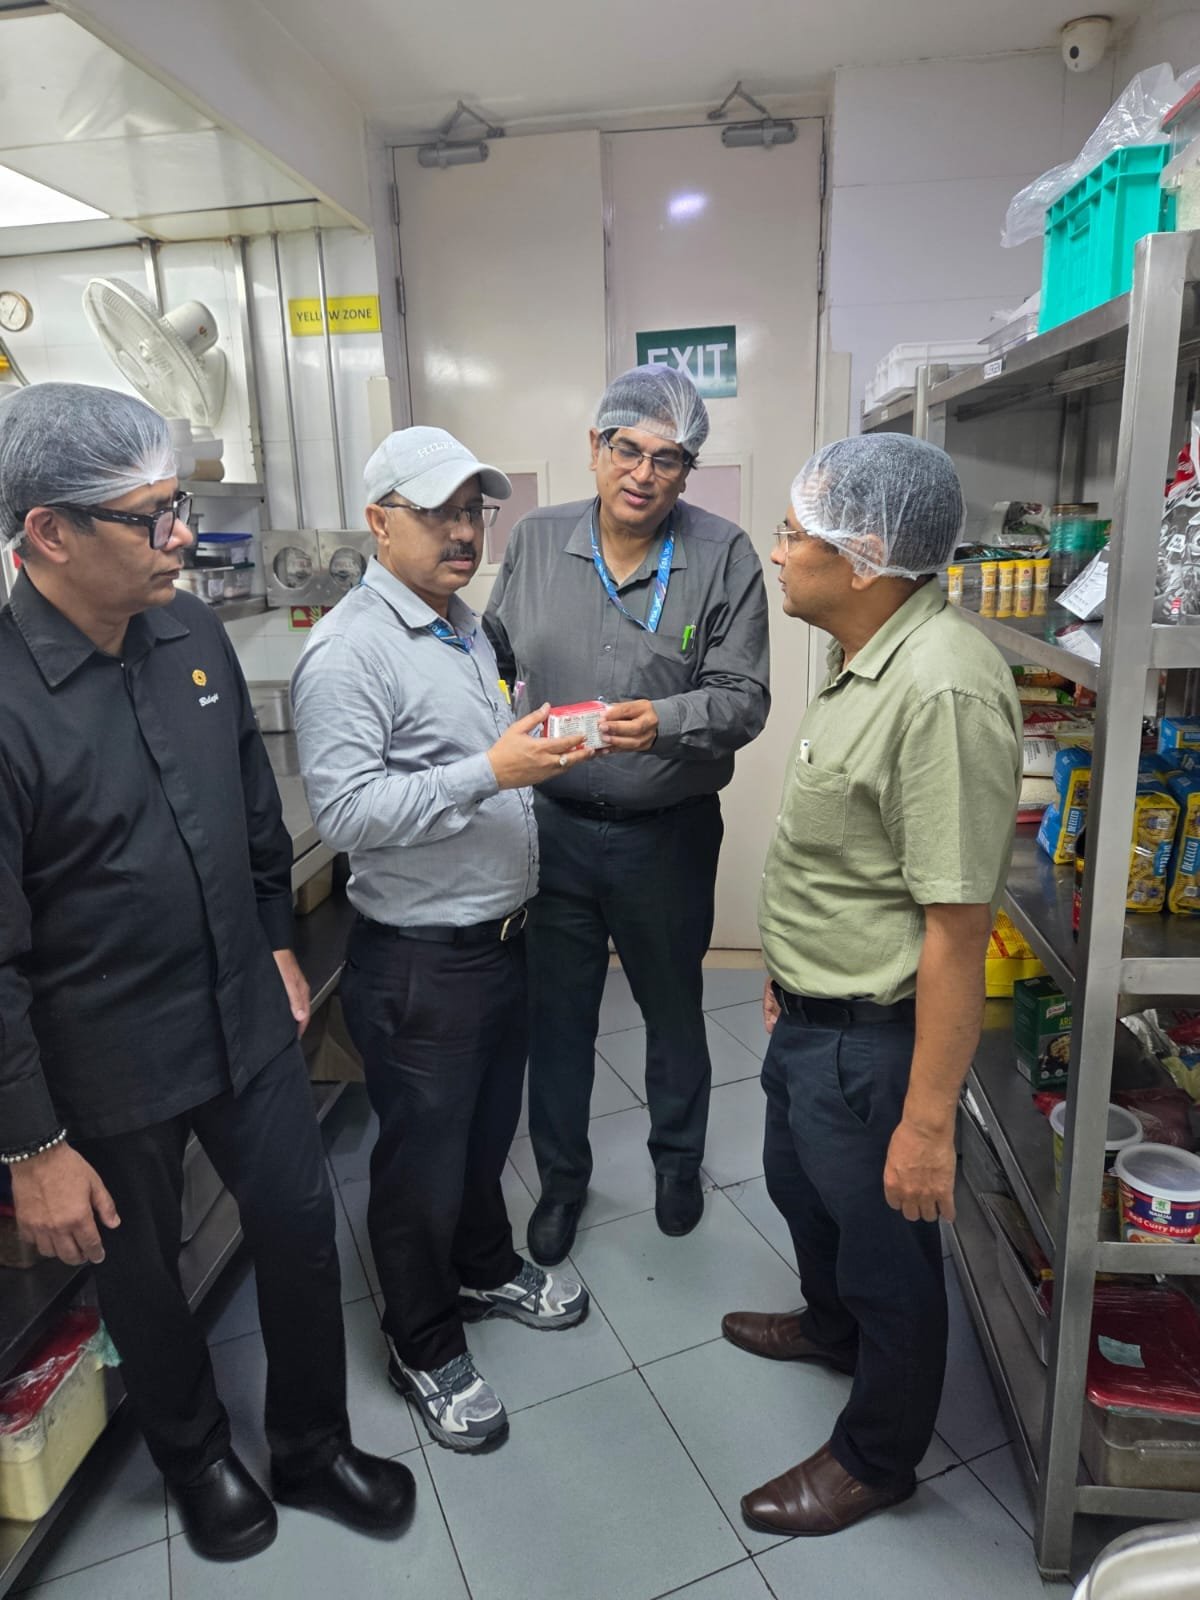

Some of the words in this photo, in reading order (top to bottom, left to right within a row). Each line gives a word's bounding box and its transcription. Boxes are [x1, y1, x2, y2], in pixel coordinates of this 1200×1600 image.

[296, 311, 340, 322] YELLW
[343, 308, 372, 320] ZONE
[1143, 1219, 1168, 1233] Curry
[1169, 1226, 1192, 1234] Paste
